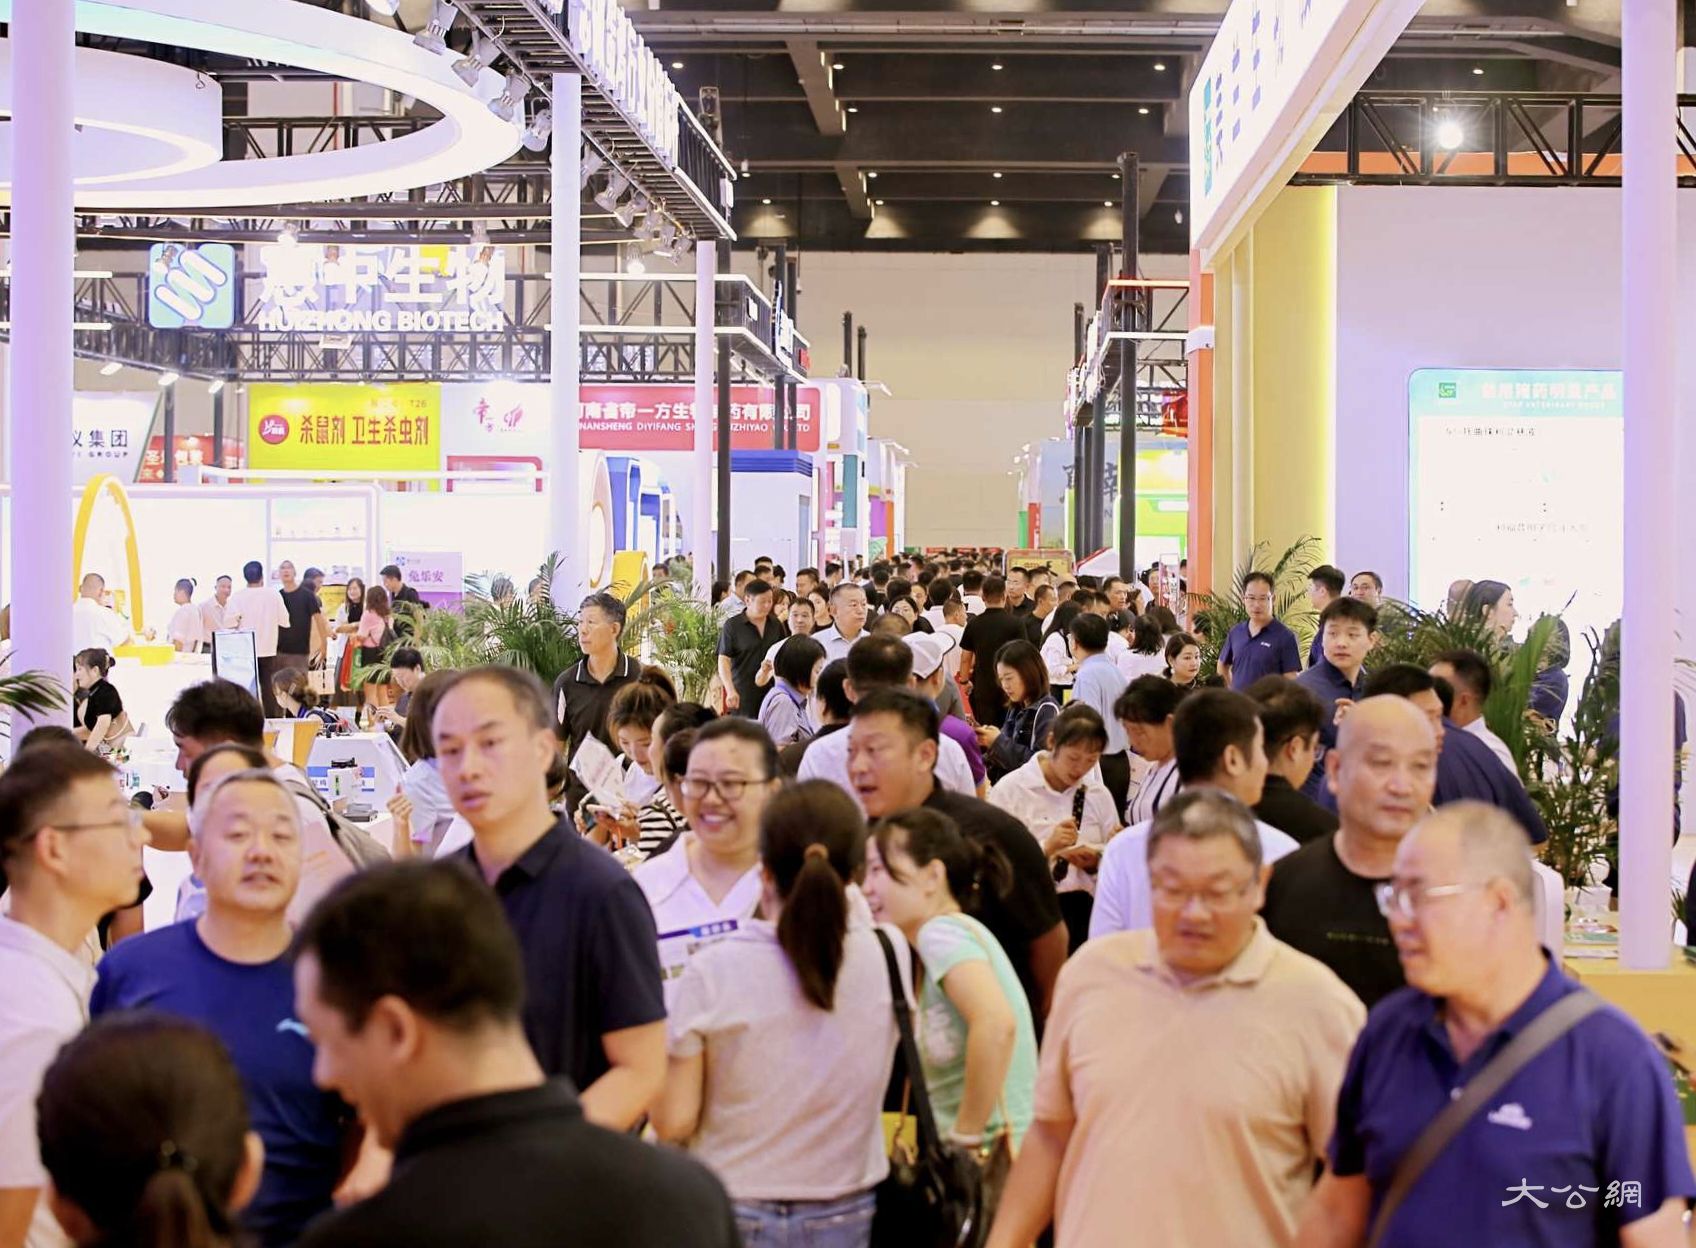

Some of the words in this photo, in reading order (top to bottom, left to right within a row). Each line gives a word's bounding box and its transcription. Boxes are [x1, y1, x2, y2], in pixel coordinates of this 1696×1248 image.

[397, 310, 504, 332] BIOTECH
[300, 415, 345, 445] 杀鼠剂
[351, 415, 429, 445] 卫生杀虫剂
